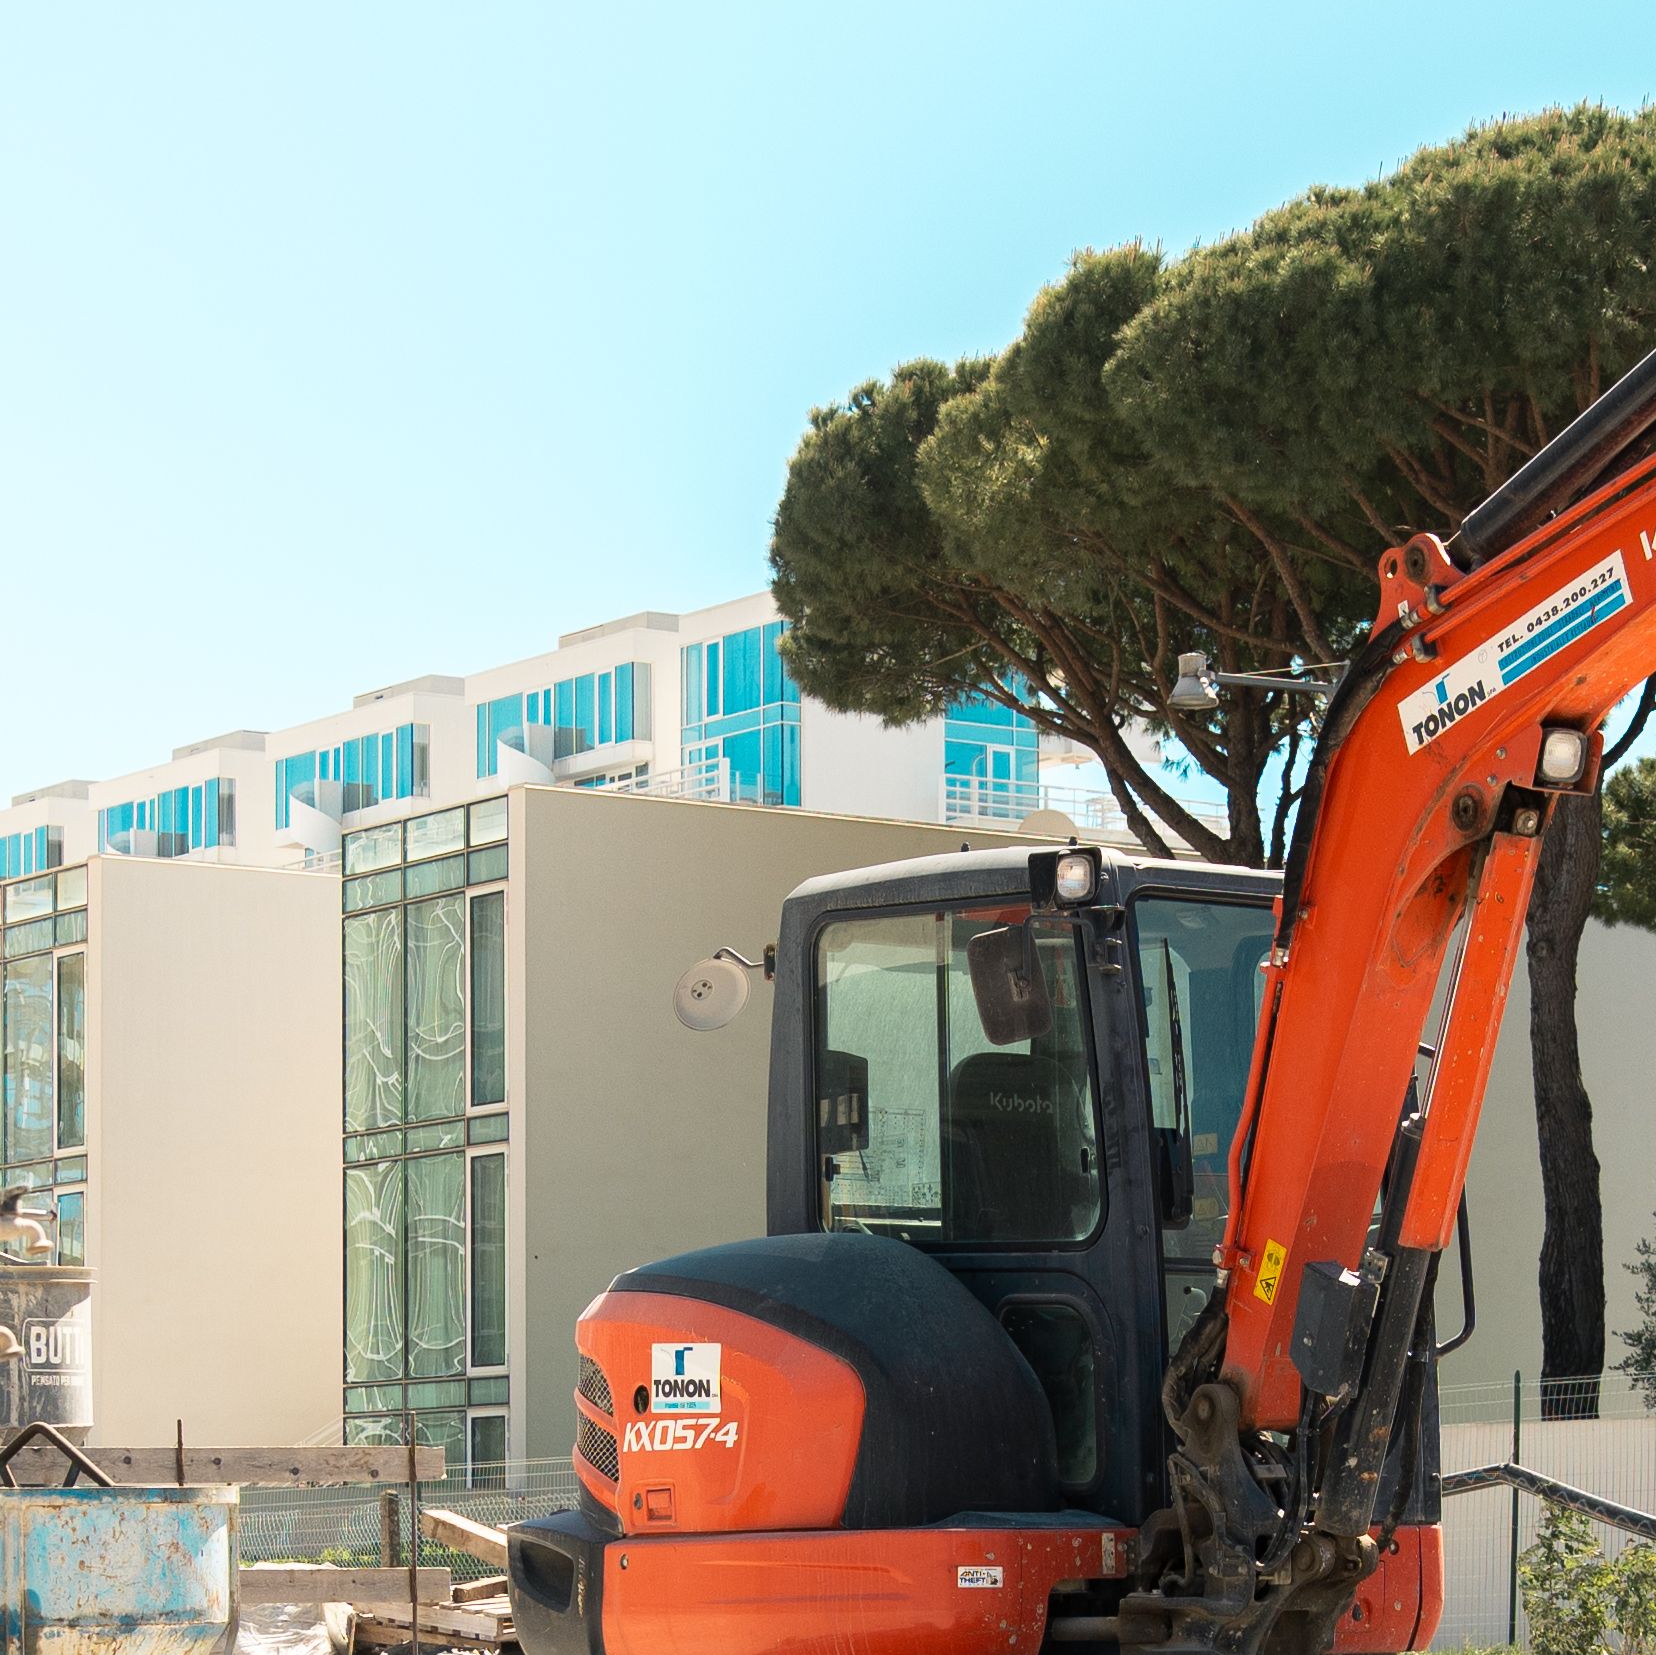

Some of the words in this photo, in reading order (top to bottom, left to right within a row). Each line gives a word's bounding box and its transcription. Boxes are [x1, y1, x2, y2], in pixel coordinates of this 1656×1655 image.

[1497, 633, 1524, 653] TEL.
[1526, 566, 1614, 633] 0438.200.227
[1412, 679, 1487, 745] TONON
[990, 1092, 1054, 1113] Kubota
[653, 1379, 711, 1398] TONON
